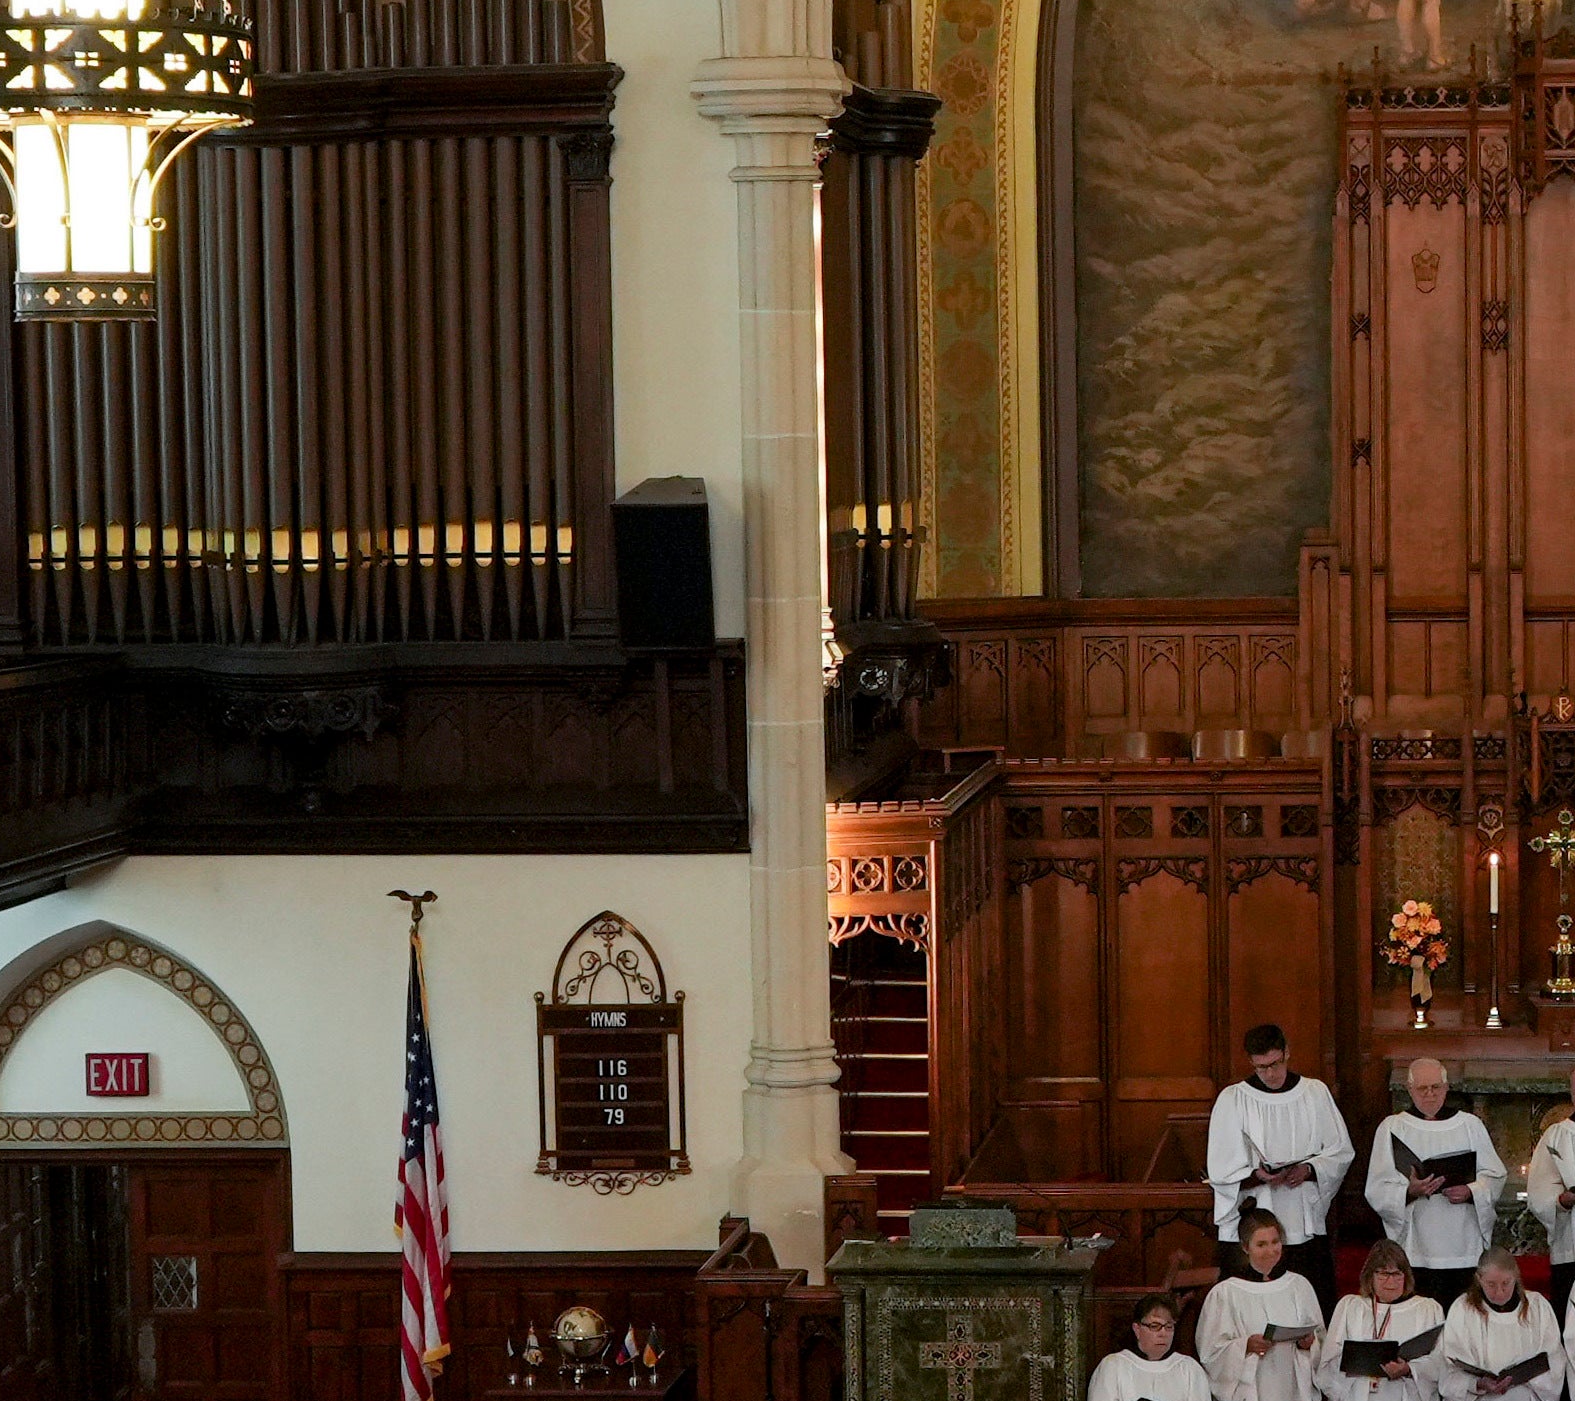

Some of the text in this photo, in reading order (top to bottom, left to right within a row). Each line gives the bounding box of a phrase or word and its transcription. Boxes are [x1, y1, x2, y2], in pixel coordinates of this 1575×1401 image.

[590, 1012, 627, 1027] HYMNS
[89, 1058, 143, 1091] EXIT
[598, 1059, 627, 1076] 116
[599, 1084, 628, 1101] 110
[604, 1109, 624, 1125] 79
